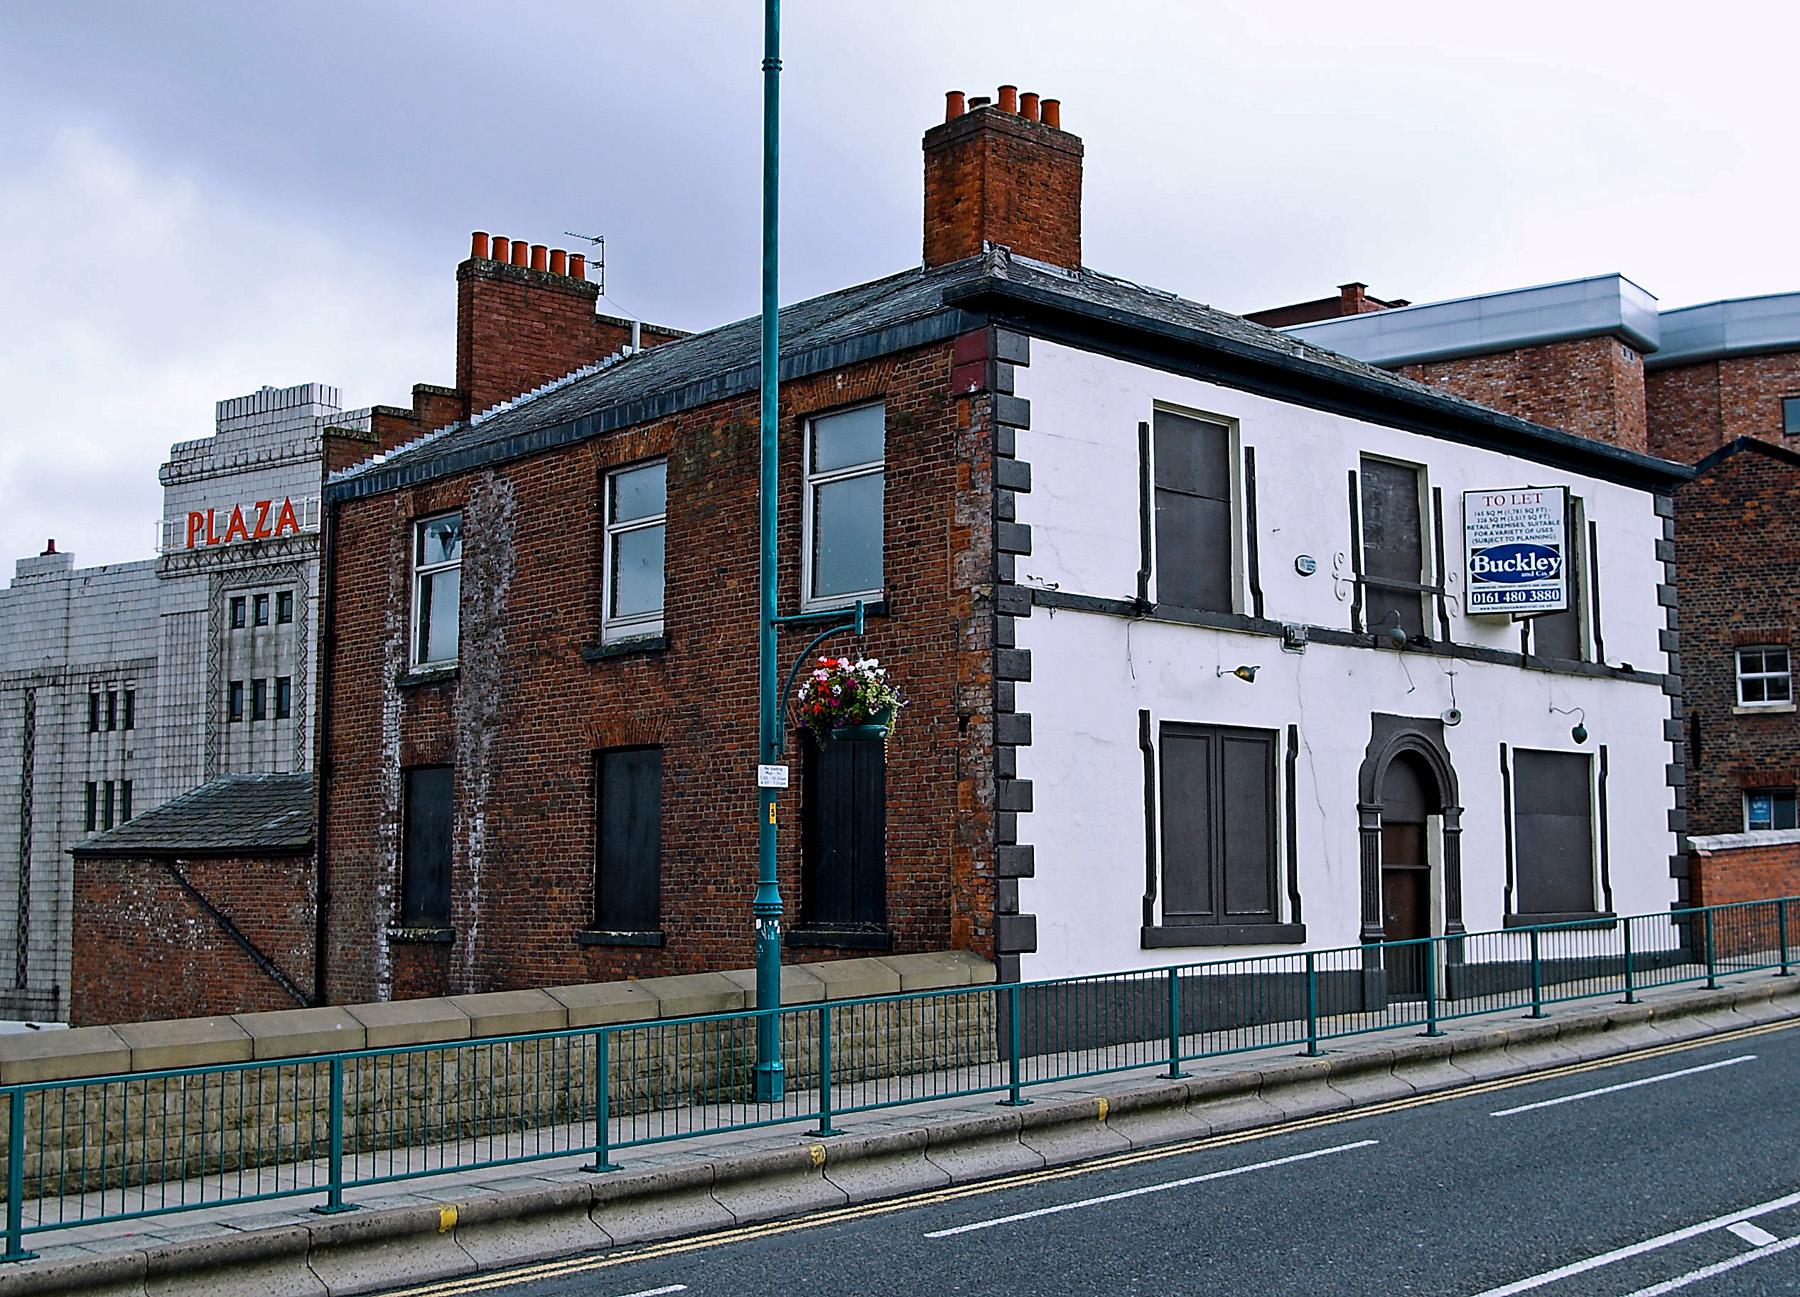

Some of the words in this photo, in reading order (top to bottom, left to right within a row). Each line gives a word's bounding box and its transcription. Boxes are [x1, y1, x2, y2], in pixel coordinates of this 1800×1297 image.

[1483, 495, 1505, 506] TO
[1511, 493, 1543, 505] LET
[187, 496, 300, 549] PLAZA
[1472, 552, 1561, 575] Buckley
[1473, 592, 1499, 603] 0161
[1503, 591, 1526, 602] 480
[1529, 590, 1560, 601] 3880
